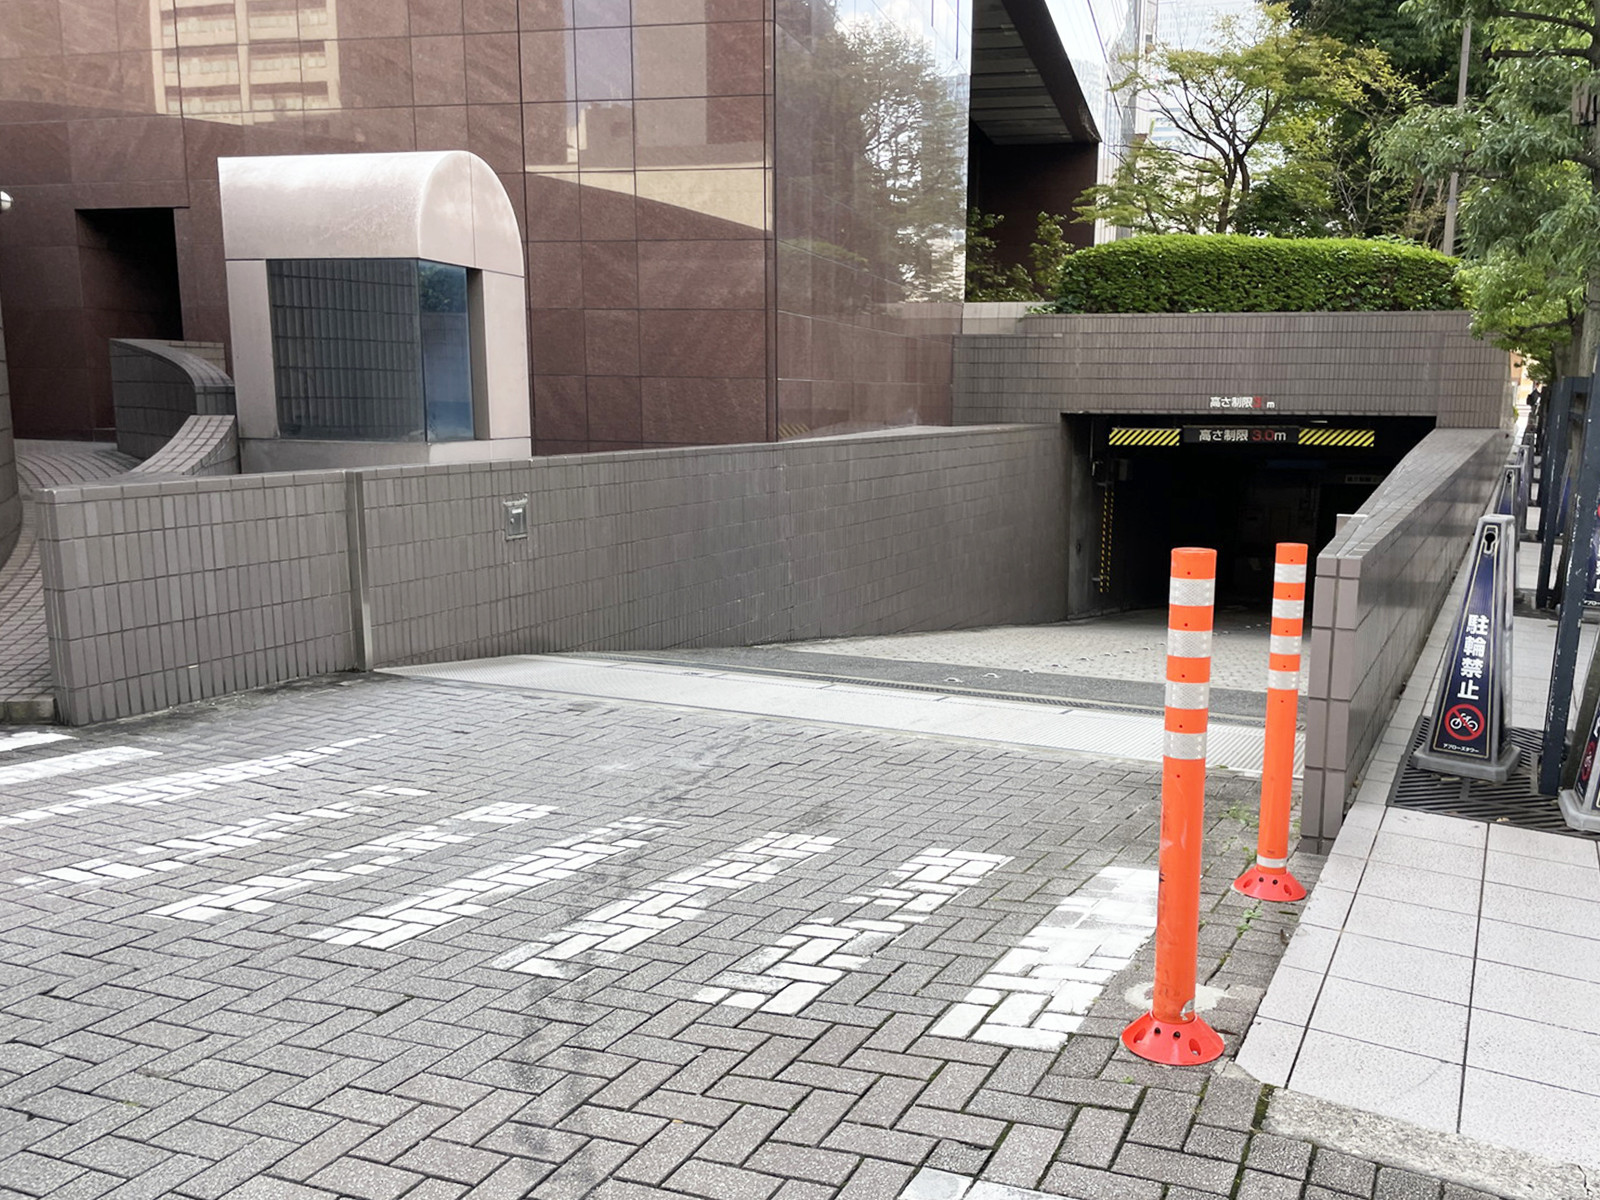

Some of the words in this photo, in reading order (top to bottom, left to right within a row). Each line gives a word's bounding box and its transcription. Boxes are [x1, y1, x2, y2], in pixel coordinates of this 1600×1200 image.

[1199, 429, 1248, 441] 高さ制限
[1457, 614, 1489, 700] 駐輪禁止
